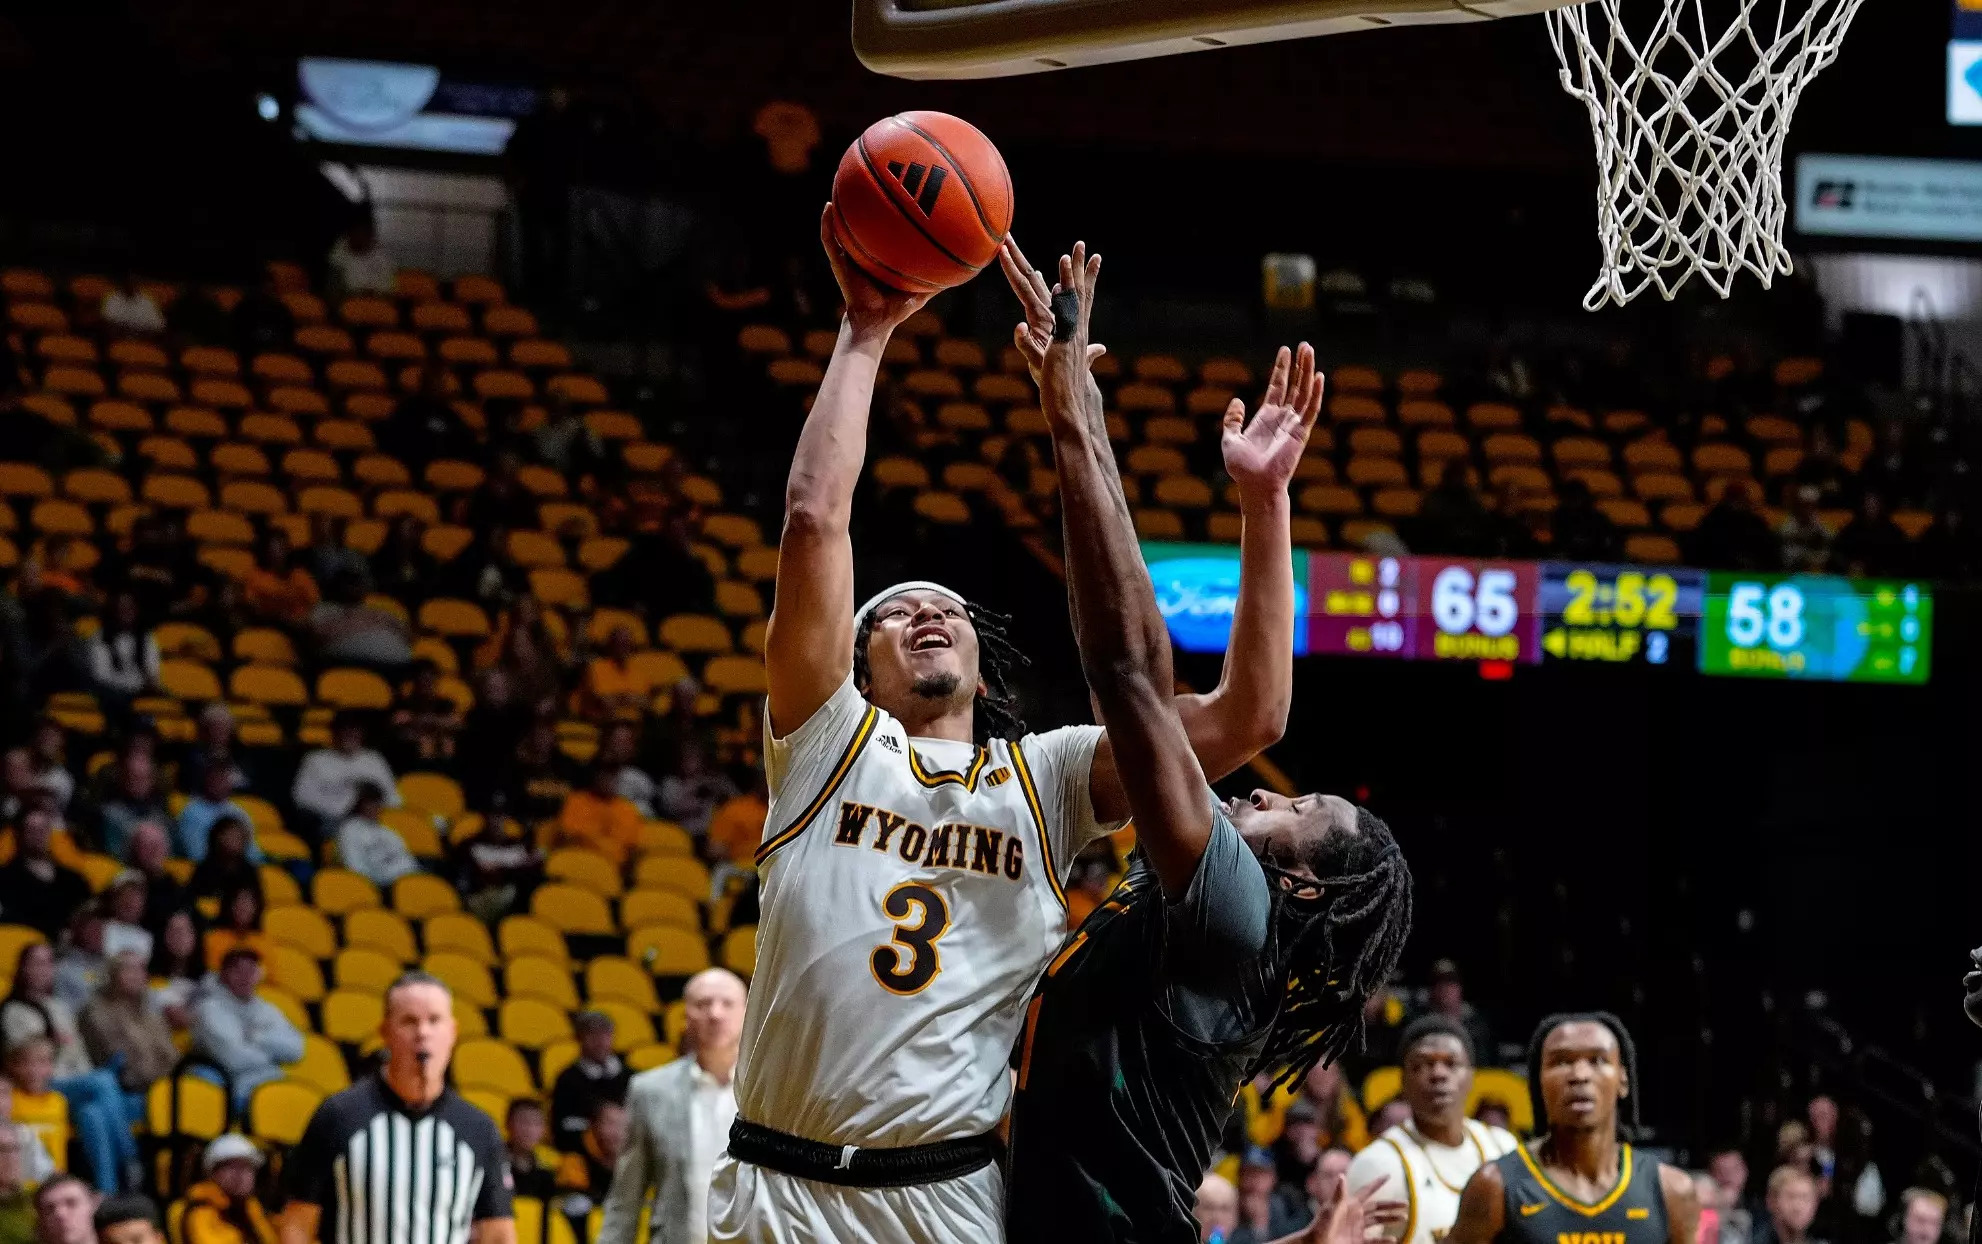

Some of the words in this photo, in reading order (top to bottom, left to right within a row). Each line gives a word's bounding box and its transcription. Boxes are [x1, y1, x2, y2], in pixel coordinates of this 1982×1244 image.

[1432, 566, 1519, 635] 65
[1564, 569, 1678, 630] 2:52
[1726, 582, 1804, 649] 58
[875, 737, 902, 755] adidas
[832, 800, 1024, 881] WYOMING
[869, 881, 952, 996] 3
